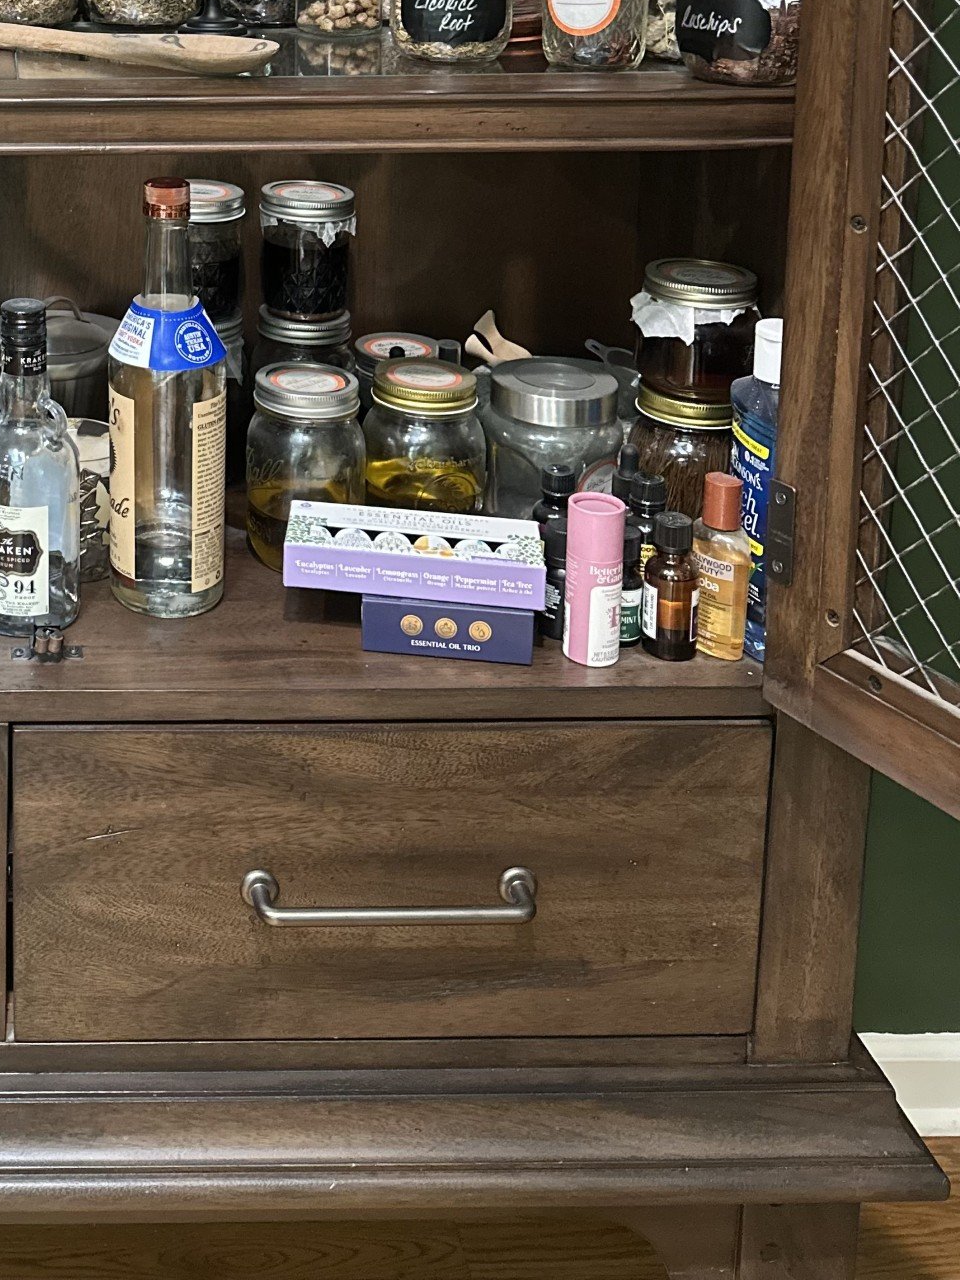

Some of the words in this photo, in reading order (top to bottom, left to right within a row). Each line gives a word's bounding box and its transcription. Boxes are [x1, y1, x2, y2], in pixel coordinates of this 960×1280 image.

[439, 13, 474, 31] Root
[187, 343, 207, 353] USA
[442, 519, 472, 527] OILS
[0, 561, 14, 569] RUM
[295, 559, 334, 571] Eucalyptus
[338, 563, 372, 574] Lavender
[376, 567, 419, 580] Lemongrass
[423, 571, 450, 582] Orange
[454, 574, 498, 587] Peppermint
[501, 578, 515, 588] Tea
[517, 580, 533, 589] Tree
[597, 575, 606, 584] &
[14, 579, 37, 595] 94
[410, 639, 447, 649] ESSENTIAL
[448, 642, 461, 650] OIL
[463, 643, 481, 652] TRIO
